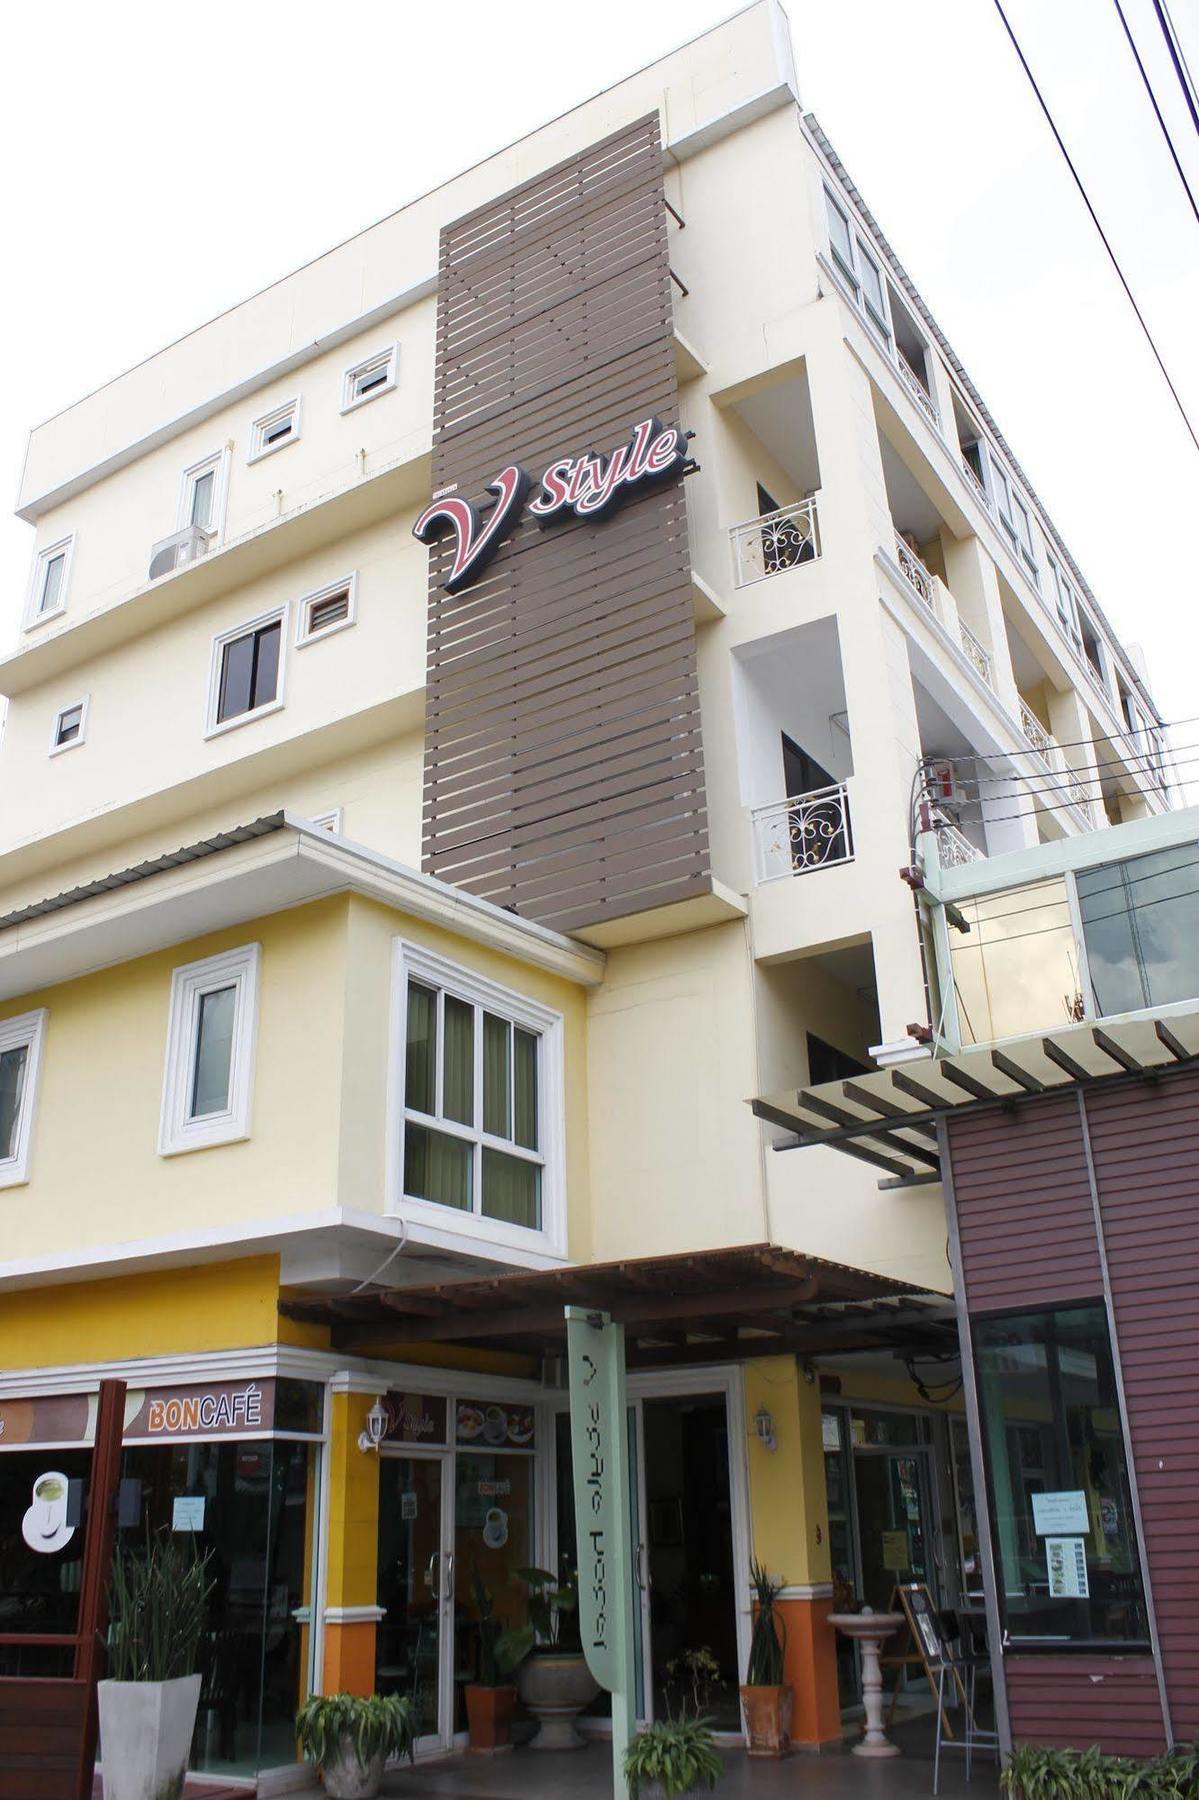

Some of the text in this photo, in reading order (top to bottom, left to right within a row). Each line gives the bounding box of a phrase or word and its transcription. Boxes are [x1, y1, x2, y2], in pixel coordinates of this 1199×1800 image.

[413, 417, 679, 590] V Style
[148, 1382, 262, 1432] BONCAFÉ
